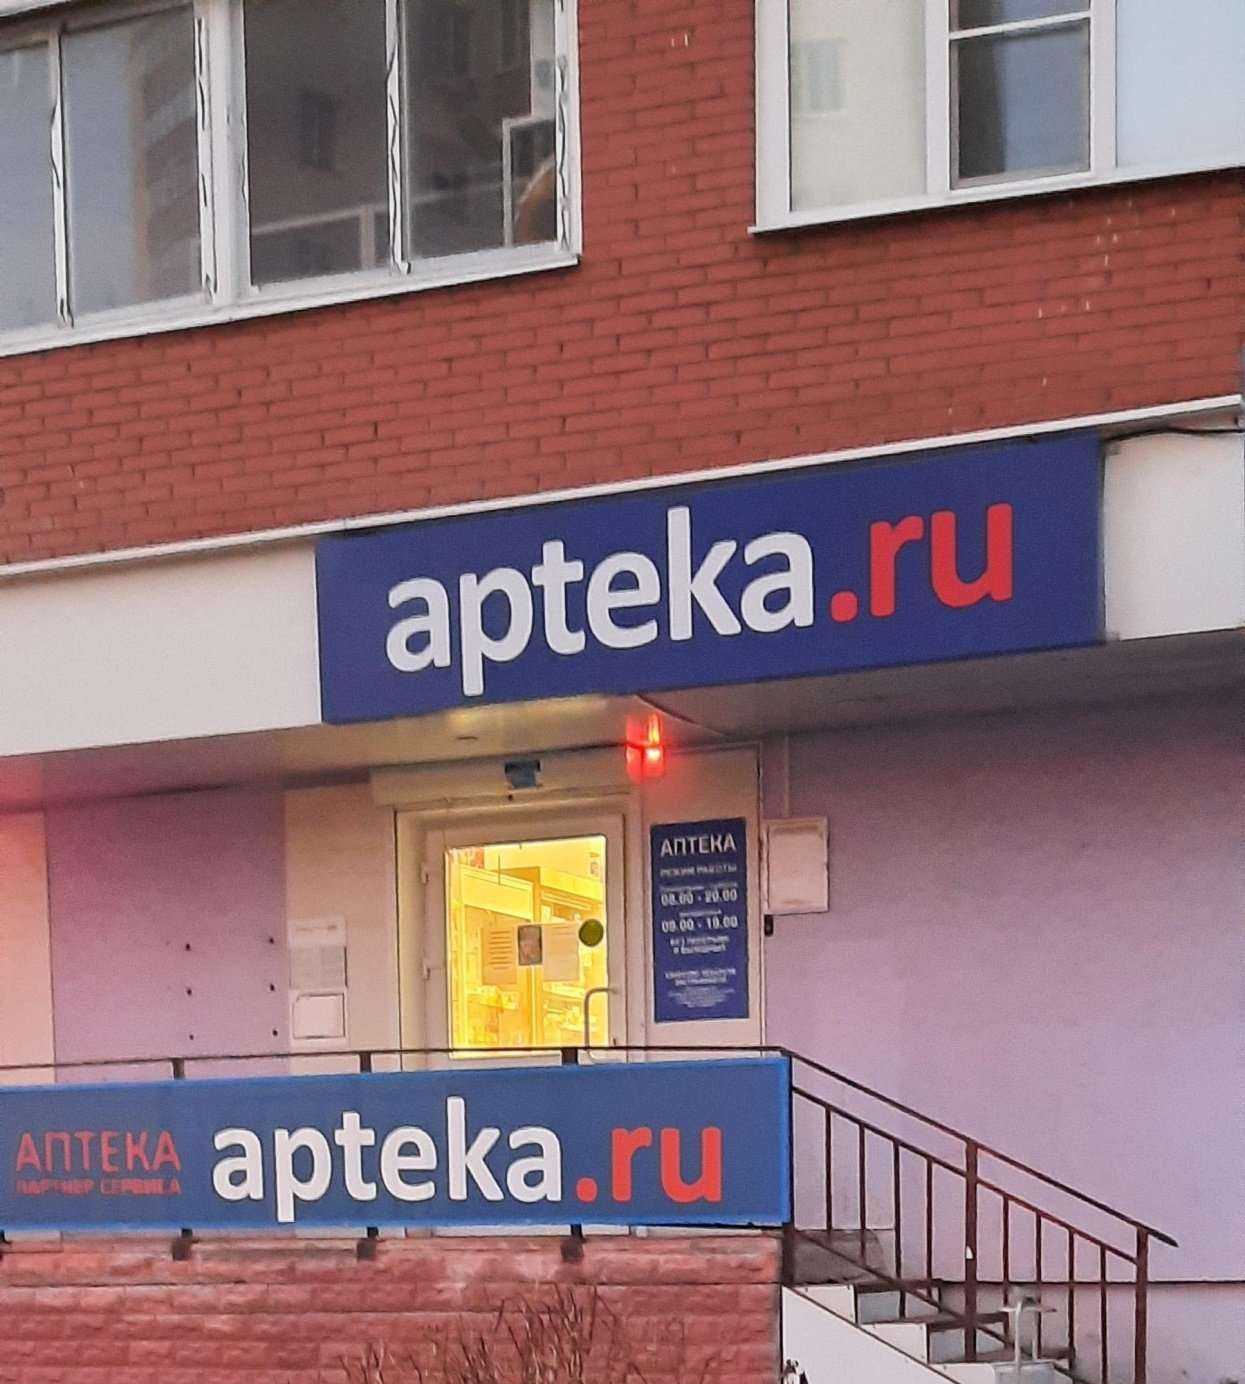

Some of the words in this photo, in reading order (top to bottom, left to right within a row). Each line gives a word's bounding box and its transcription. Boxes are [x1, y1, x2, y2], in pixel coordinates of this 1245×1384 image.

[386, 503, 1015, 697] apteka.ru
[661, 832, 738, 857] АПТЕКА
[15, 1130, 182, 1174] АПТЕКА
[212, 1096, 723, 1223] apteka.ru
